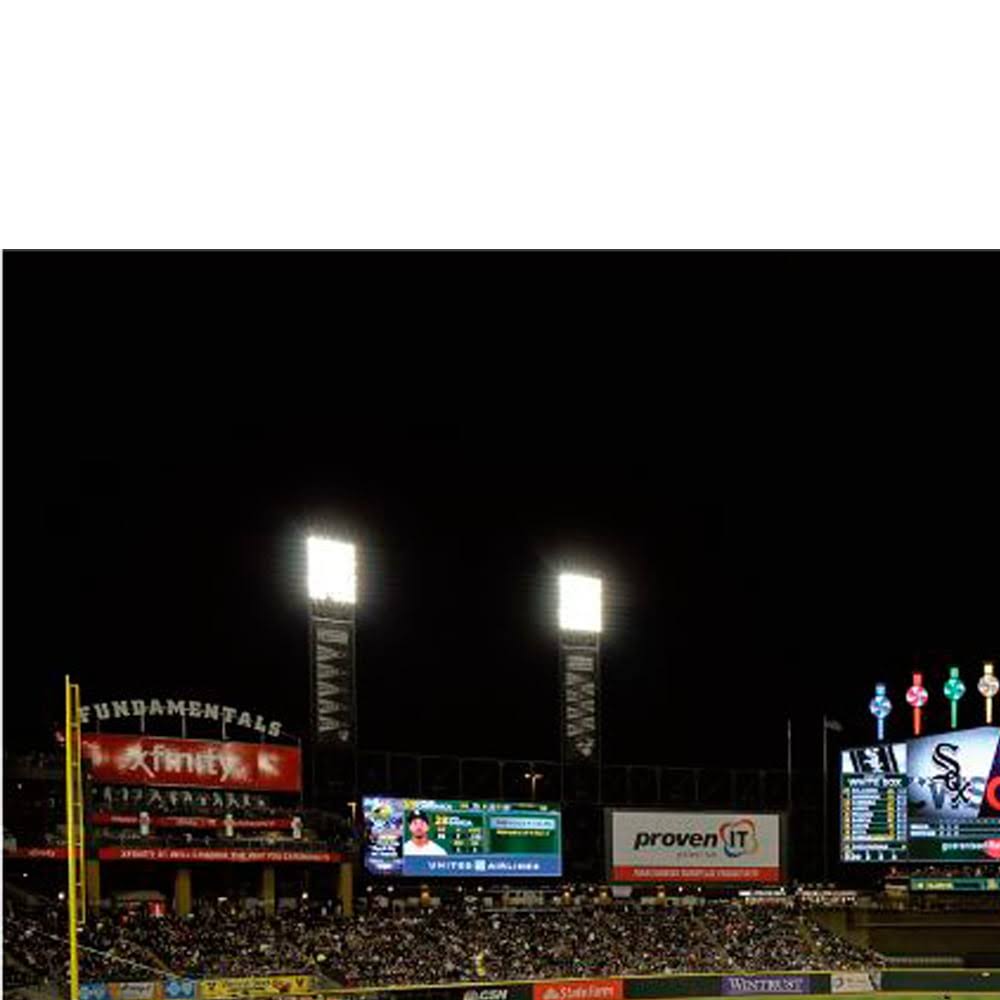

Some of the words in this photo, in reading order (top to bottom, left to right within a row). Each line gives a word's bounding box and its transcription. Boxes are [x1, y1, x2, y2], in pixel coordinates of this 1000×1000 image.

[80, 698, 283, 738] FUNDAMENTALS
[634, 830, 718, 850] proven
[730, 830, 749, 848] IT
